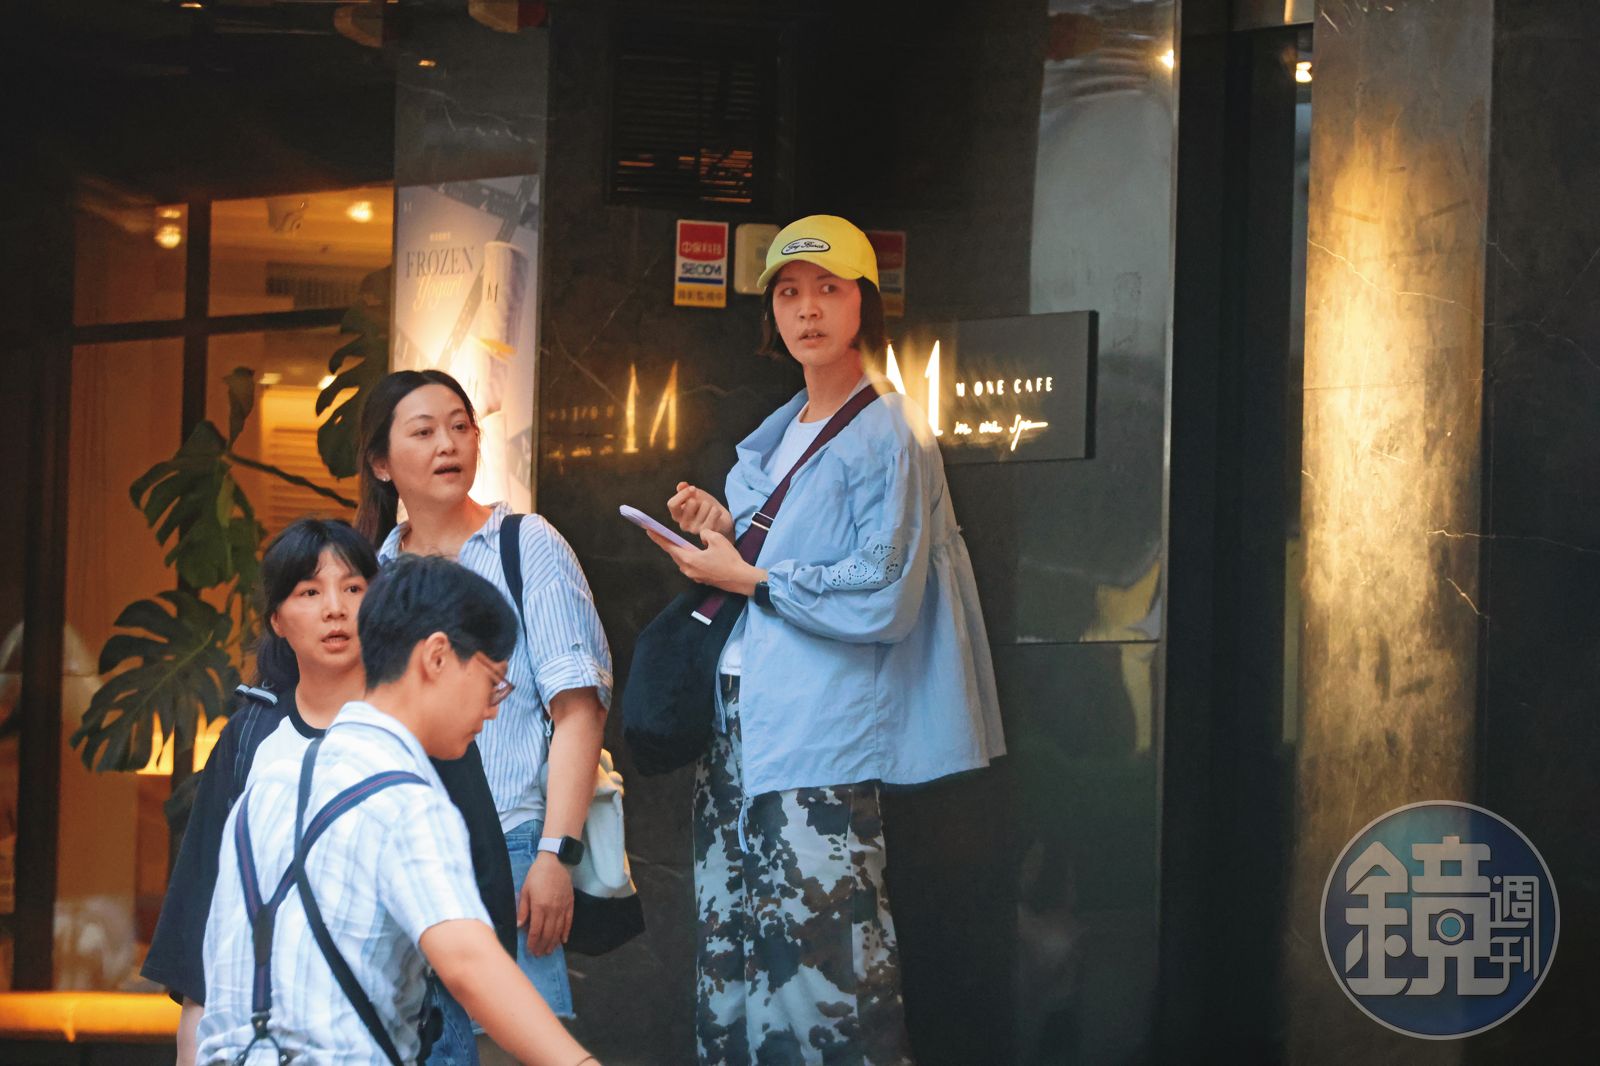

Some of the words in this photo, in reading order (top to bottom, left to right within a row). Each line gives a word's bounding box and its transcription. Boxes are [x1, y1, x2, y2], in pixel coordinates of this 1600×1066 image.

[405, 246, 474, 278] FROZEN
[682, 263, 722, 276] SECOM
[974, 379, 1005, 397] ONE
[1013, 376, 1053, 395] CAFE
